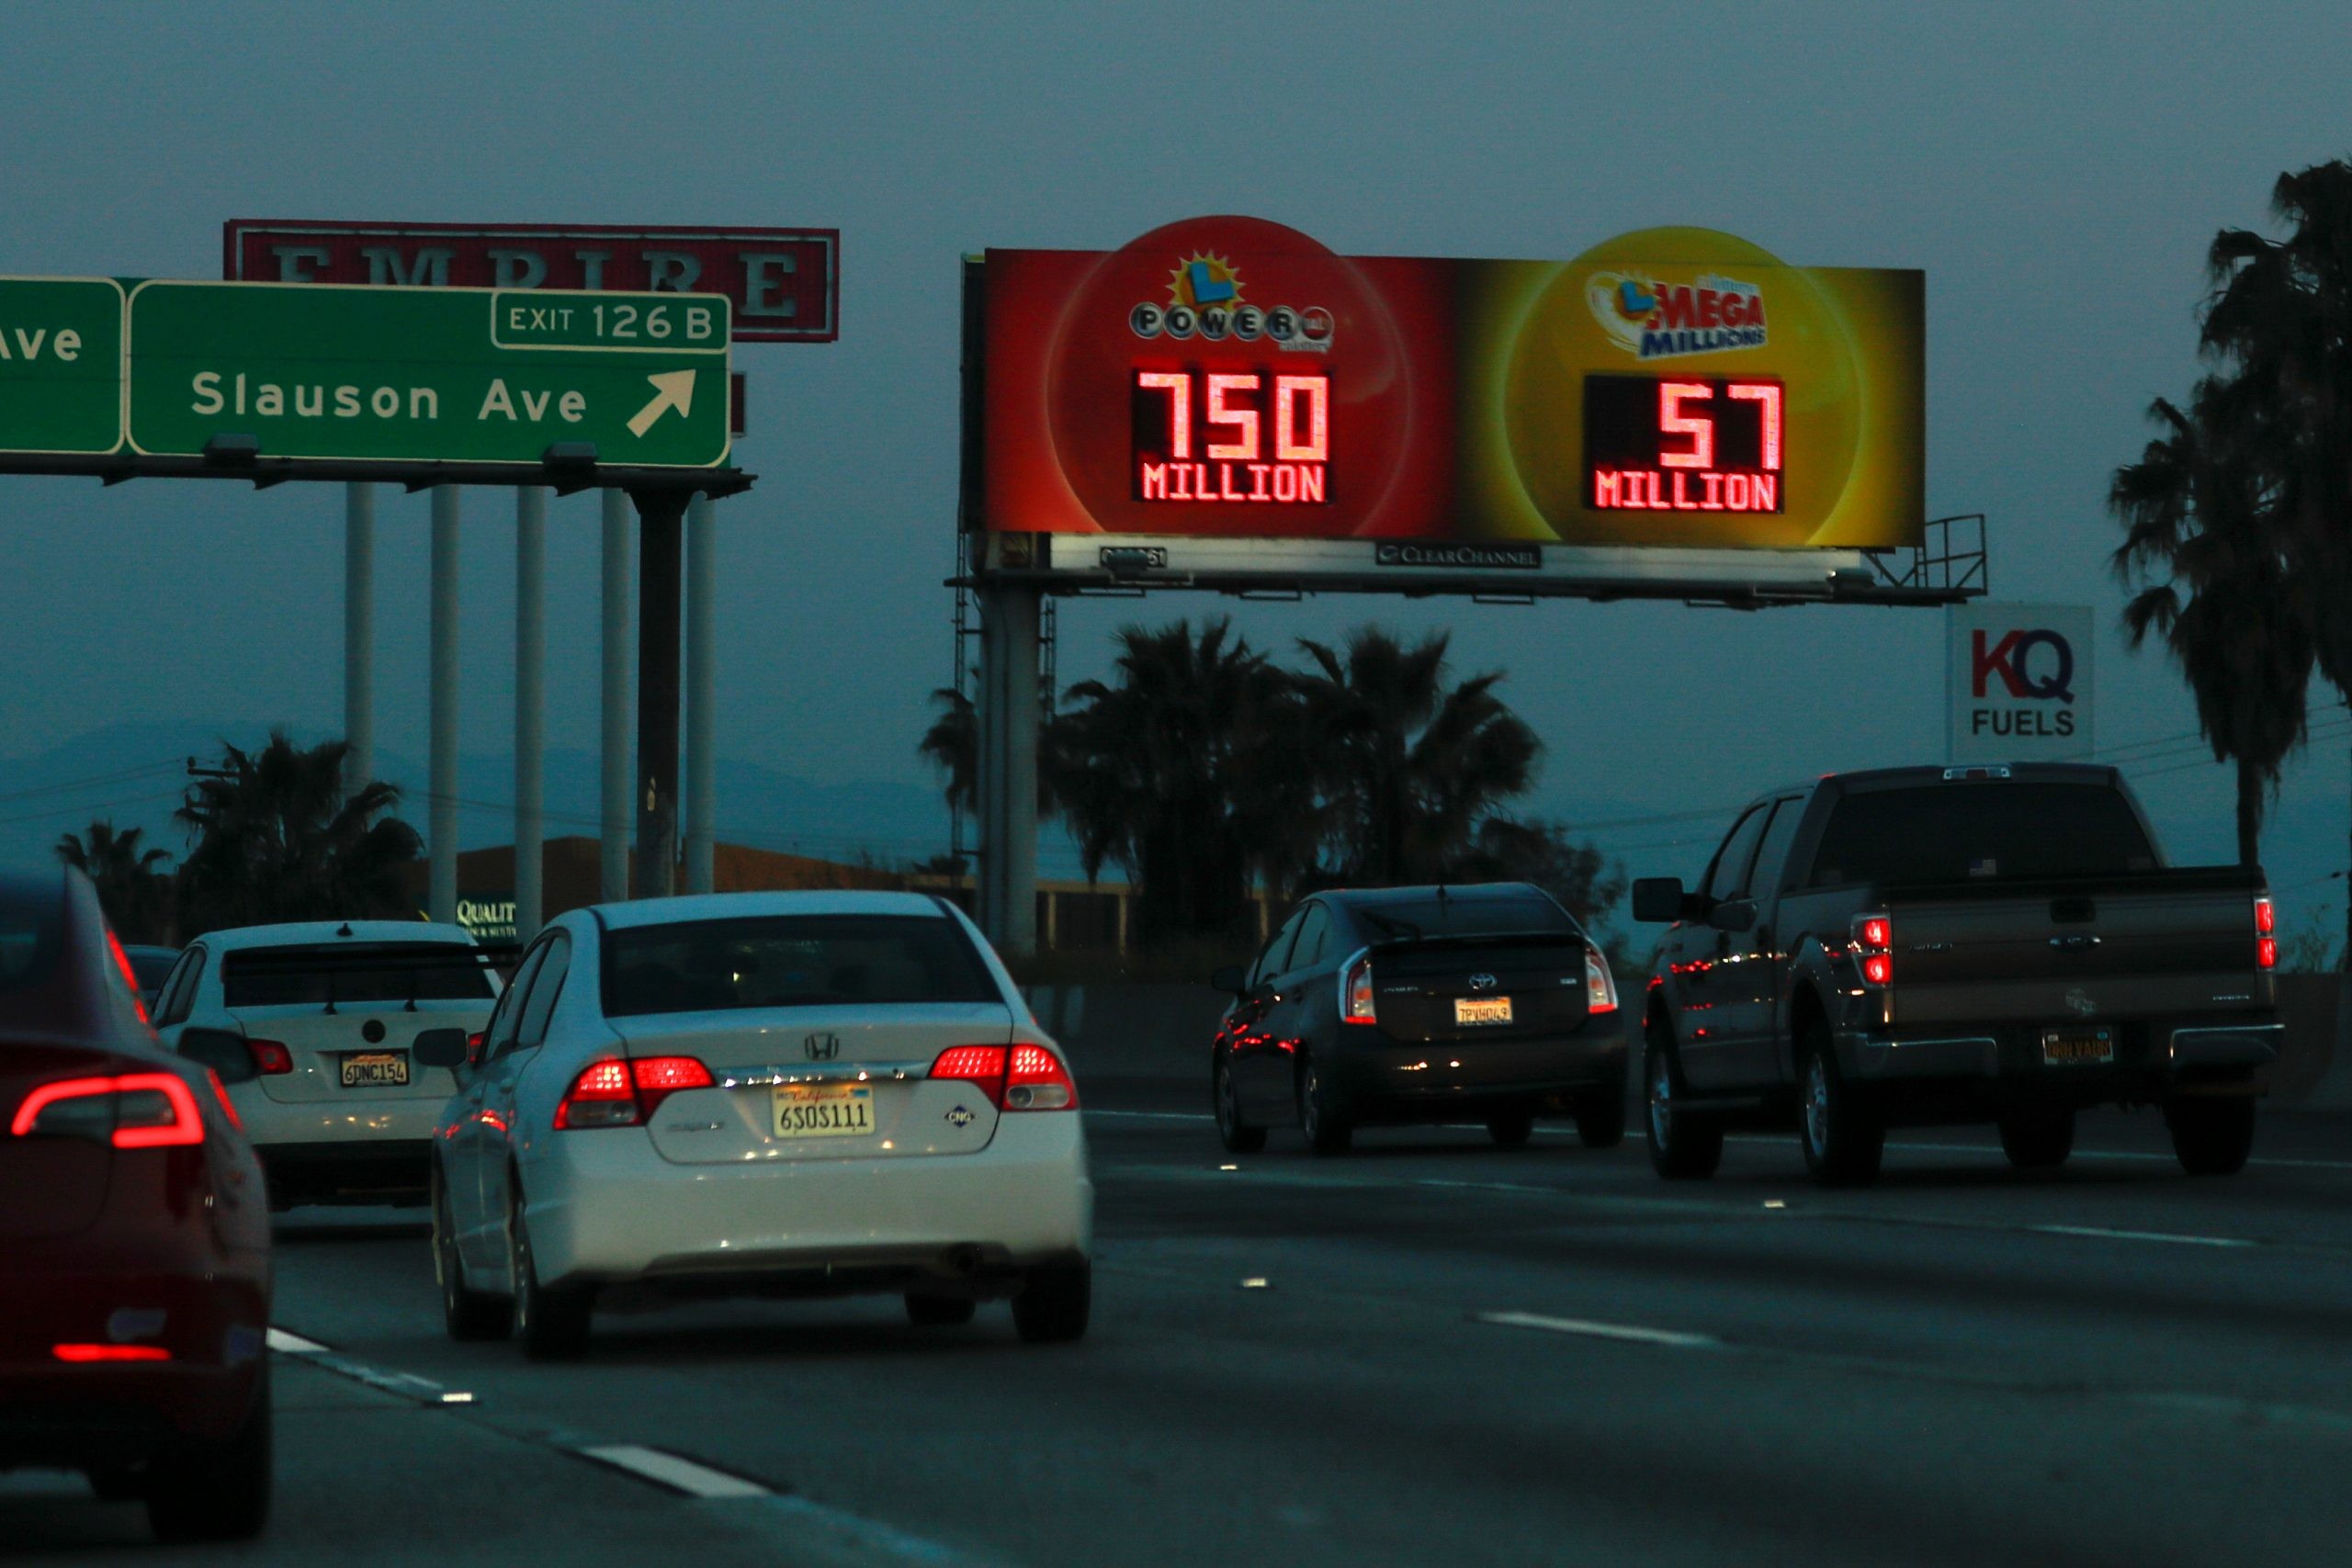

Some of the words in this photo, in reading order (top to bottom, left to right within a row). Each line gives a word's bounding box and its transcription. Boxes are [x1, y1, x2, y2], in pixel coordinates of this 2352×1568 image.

[509, 307, 575, 331] EXIT
[592, 304, 673, 339] 126
[685, 307, 713, 340] B
[1646, 282, 1766, 330] MEGA
[1640, 329, 1766, 356] MILLIONS
[191, 371, 439, 419] Slauson
[477, 378, 587, 423] Ave
[1138, 372, 1329, 461] 750
[1659, 382, 1781, 470] 57
[1142, 462, 1326, 502] MILLION
[1595, 469, 1778, 512] MILLION
[1972, 628, 2075, 705] KQ
[1972, 709, 2075, 737] FUELS
[457, 899, 516, 926] QUALIT
[345, 1064, 404, 1081] 6DNC154
[780, 1103, 868, 1130] 6SOS111
